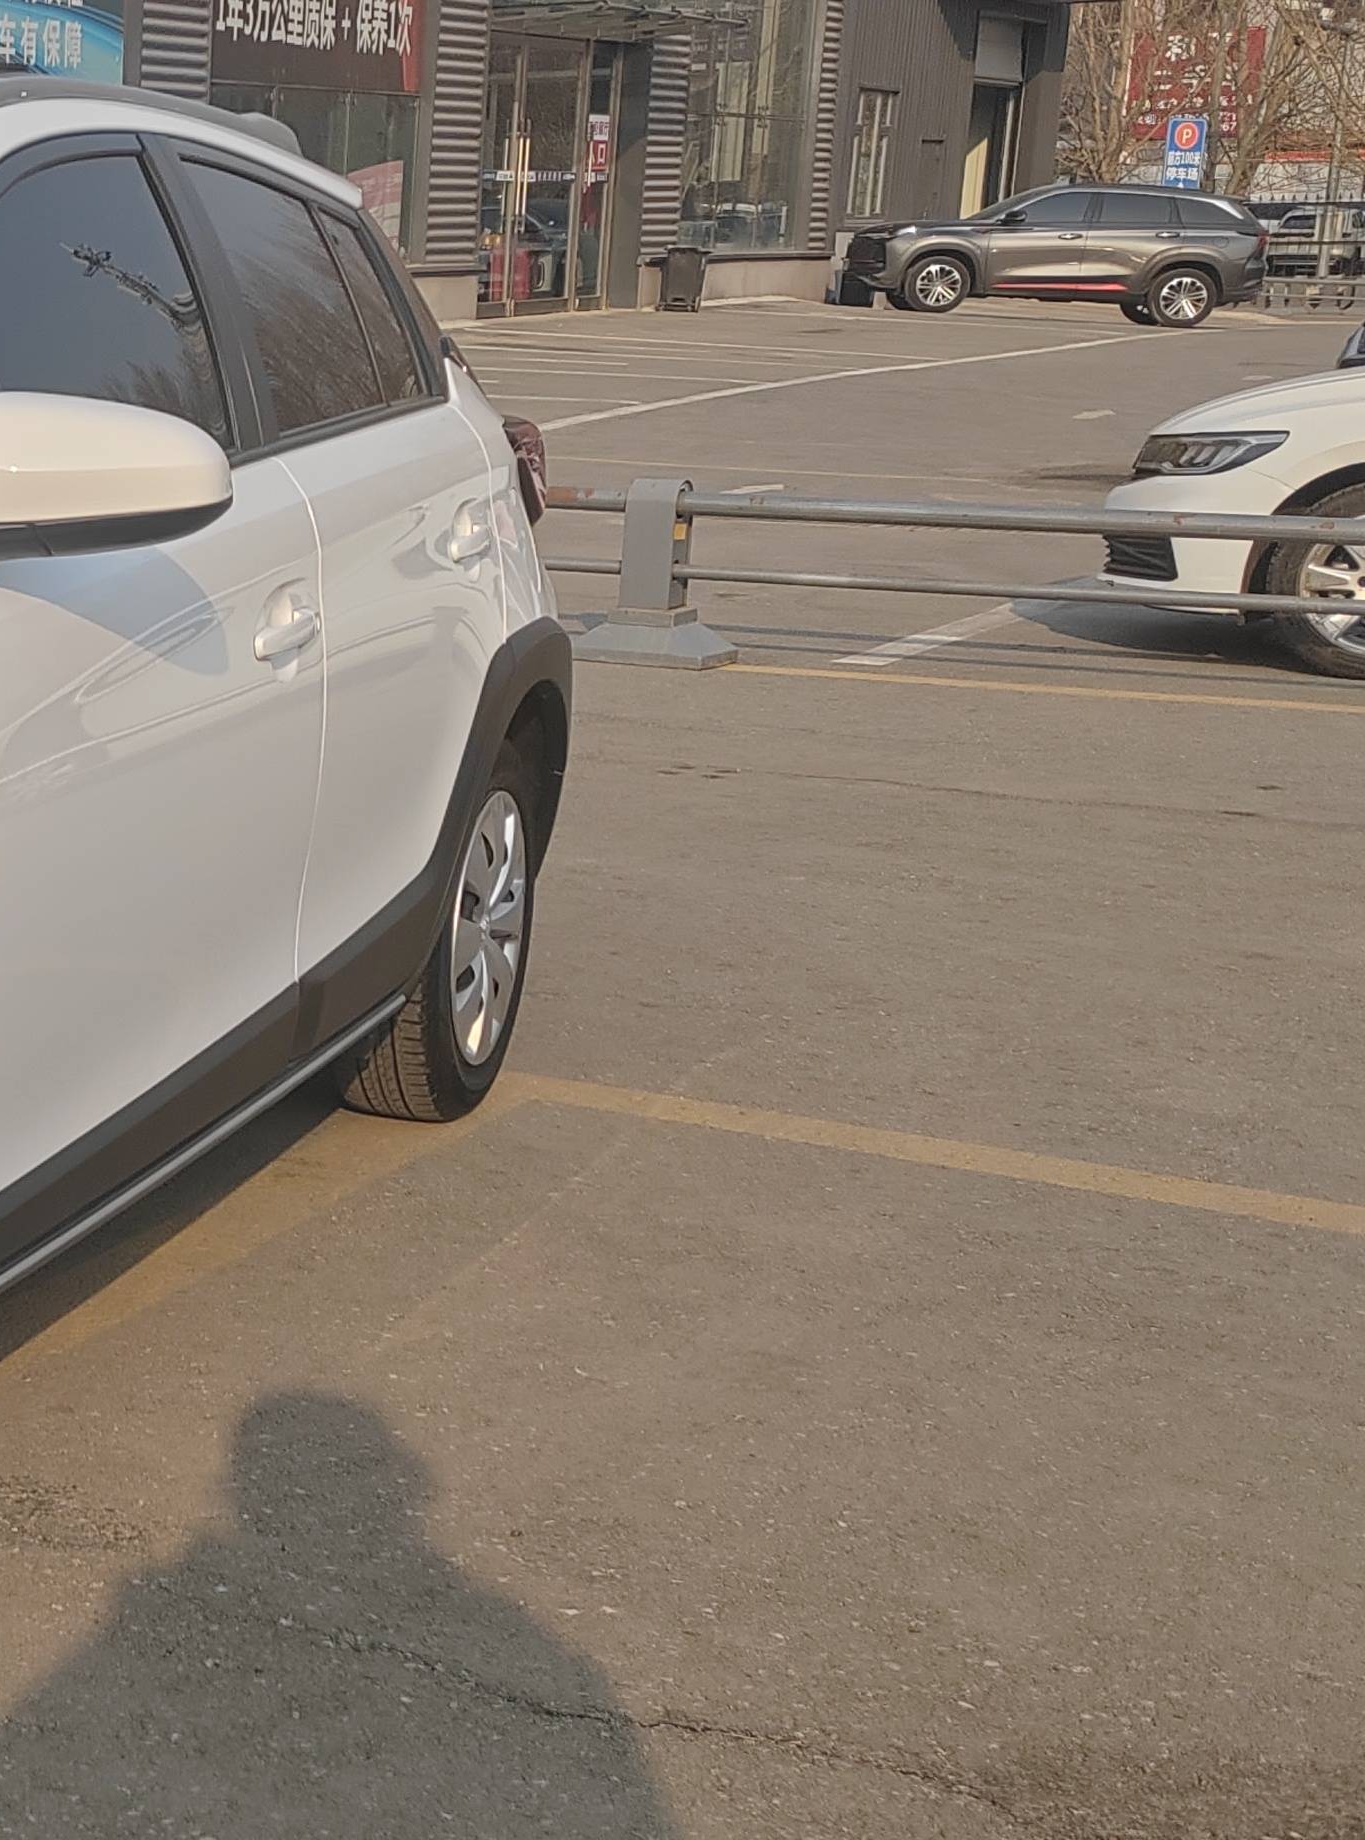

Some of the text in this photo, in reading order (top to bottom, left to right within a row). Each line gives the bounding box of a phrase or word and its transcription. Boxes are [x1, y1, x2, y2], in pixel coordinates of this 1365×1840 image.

[216, 0, 336, 50] 1年3万公里质保
[356, 0, 413, 56] 保养1次
[1182, 128, 1193, 144] P
[1167, 151, 1201, 166] 前方100米
[1166, 166, 1199, 181] 停车场
